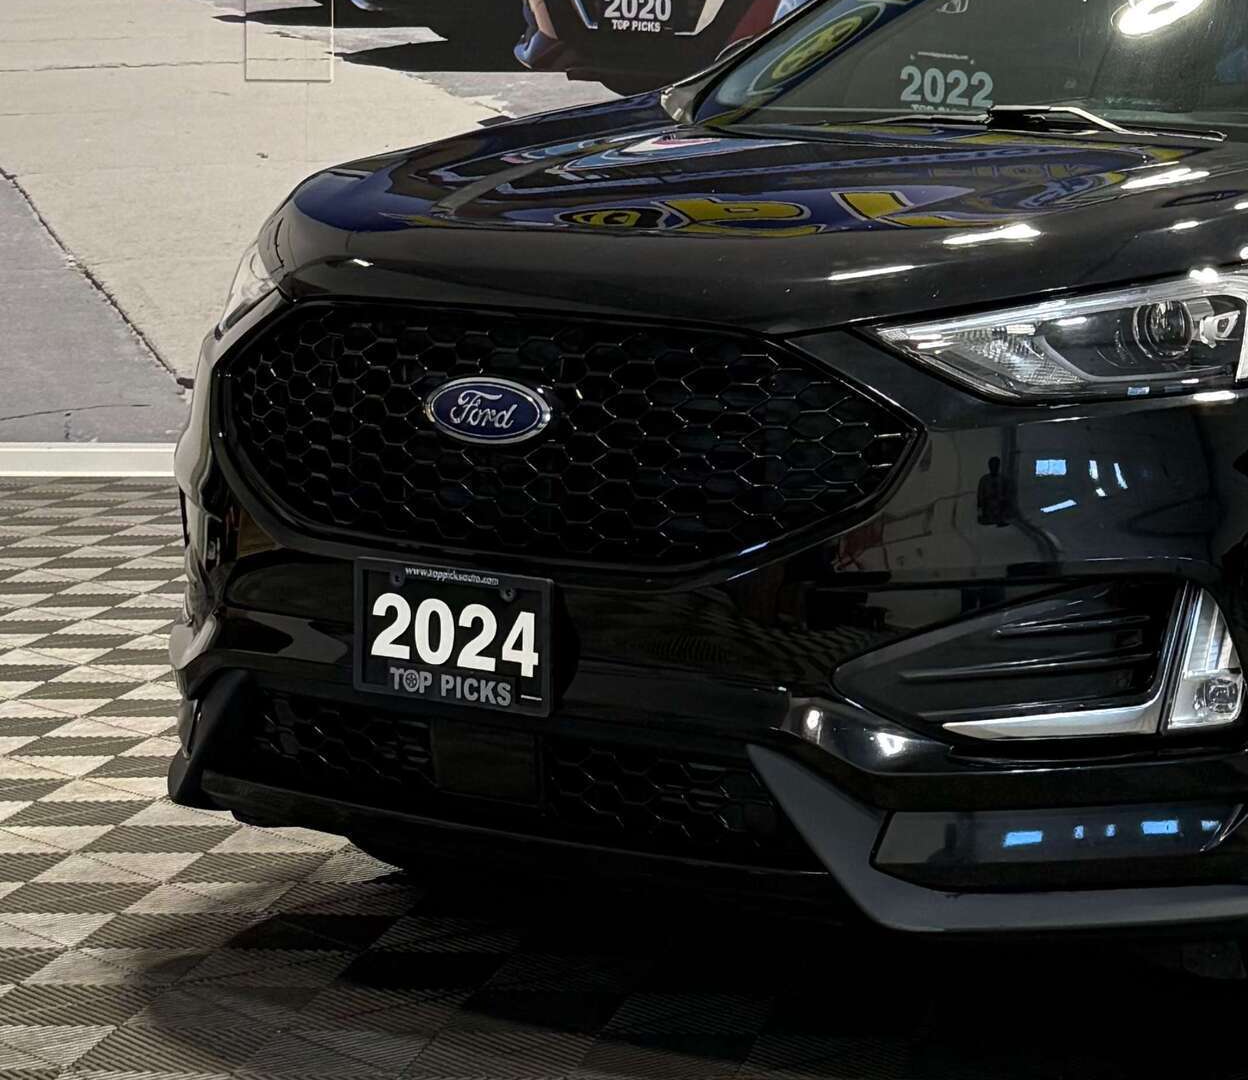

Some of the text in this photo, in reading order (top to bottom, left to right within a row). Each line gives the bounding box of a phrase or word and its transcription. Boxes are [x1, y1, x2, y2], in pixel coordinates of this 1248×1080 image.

[611, 19, 661, 33] TOP PICKS
[900, 65, 994, 108] 2022
[449, 389, 515, 430] Ford
[371, 592, 539, 678] 2024
[389, 666, 512, 707] TOP PICKS
